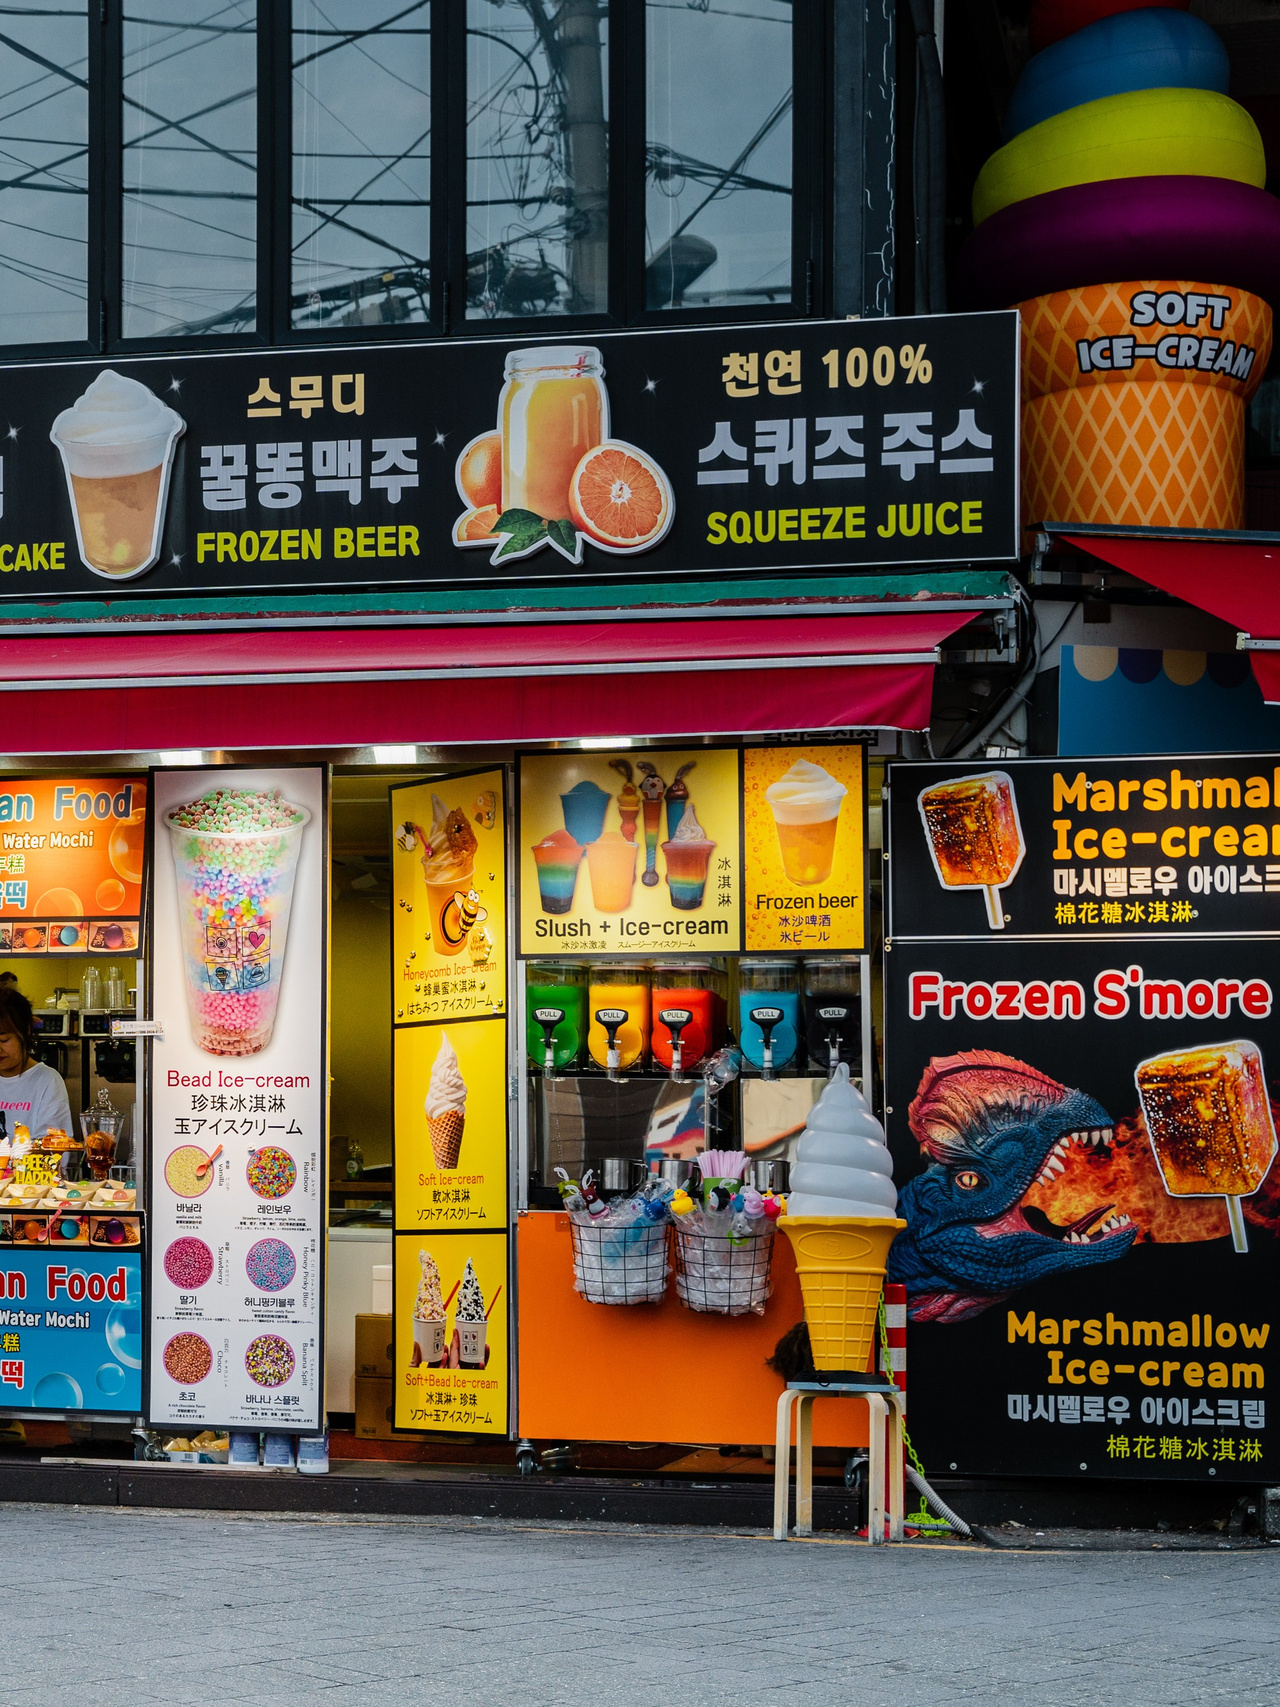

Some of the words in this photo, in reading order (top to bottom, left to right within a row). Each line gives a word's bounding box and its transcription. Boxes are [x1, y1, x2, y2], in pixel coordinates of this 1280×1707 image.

[1132, 293, 1230, 328] SOFT
[1077, 336, 1255, 380] ICE-CREAM
[721, 351, 803, 399] 천연
[822, 343, 933, 389] 100%
[246, 372, 367, 419] 스무디
[696, 415, 867, 487] 스퀴즈
[880, 408, 994, 482] 주스
[199, 436, 420, 512] 꿀똥맥주
[706, 506, 866, 548] SQUEEZE
[876, 500, 983, 540] JUICE
[196, 529, 323, 565] FROZEN
[332, 524, 420, 560] BEER
[53, 783, 134, 822] Food
[3, 831, 46, 849] Water
[50, 829, 94, 848] Mochi
[1052, 820, 1280, 860] Ice-crea
[717, 857, 732, 907] 冰淇淋
[1053, 866, 1179, 897] 마시멜로우
[756, 894, 816, 910] Frozen
[818, 893, 858, 909] beer
[778, 914, 831, 927] 冰沙啤酒
[1055, 901, 1193, 925] 棉花糖冰淇淋
[535, 918, 592, 938] Slush
[599, 922, 611, 933] +
[620, 918, 729, 937] Ice-cream
[780, 931, 830, 943] 氷ビール
[617, 940, 696, 949] スムージーアイスクリーム
[403, 966, 452, 981] Honeycomb
[454, 962, 497, 977] Ice-cream
[423, 978, 477, 998] 蜂巢蜜冰淇淋
[910, 973, 1085, 1020] Frozen
[1094, 966, 1272, 1019] S'more
[407, 998, 439, 1016] はちみつ
[441, 993, 494, 1012] アイスクリーム
[540, 1010, 558, 1018] PULL
[758, 1010, 776, 1018] PULL
[824, 1008, 842, 1017] PULL
[603, 1011, 621, 1019] PULL
[667, 1011, 685, 1019] PULL
[167, 1070, 212, 1089] Bead
[217, 1070, 310, 1089] Ice-cream
[191, 1093, 286, 1113] 珍珠冰淇淋
[174, 1117, 303, 1137] 玉アイスクリーム
[22, 1155, 44, 1171] BEE
[16, 1171, 58, 1187] HAPPY
[418, 1174, 437, 1186] Soft
[439, 1173, 484, 1186] Ice-cream
[176, 1203, 202, 1213] 바닐라
[257, 1204, 292, 1215] 레인보우
[417, 1206, 486, 1221] ソフトアイスクリーム
[47, 1264, 128, 1303] Food
[180, 1295, 197, 1305] 딸기
[244, 1297, 296, 1308] 허니핑키블루
[45, 1310, 90, 1329] Mochi
[1007, 1310, 1271, 1349] Marshmallow
[1047, 1350, 1265, 1389] Ice-cream
[405, 1373, 451, 1389] Soft+Bead
[453, 1374, 498, 1390] Ice-cream
[179, 1392, 196, 1401] 초코
[246, 1393, 271, 1404] 바나나
[460, 1393, 478, 1407] 珍珠
[410, 1408, 492, 1425] ソフト+玉アイスクリーム
[1007, 1394, 1131, 1424] 마시멜로우
[1140, 1397, 1266, 1430] 아이스크림
[1106, 1434, 1263, 1463] 棉花糖冰淇淋
